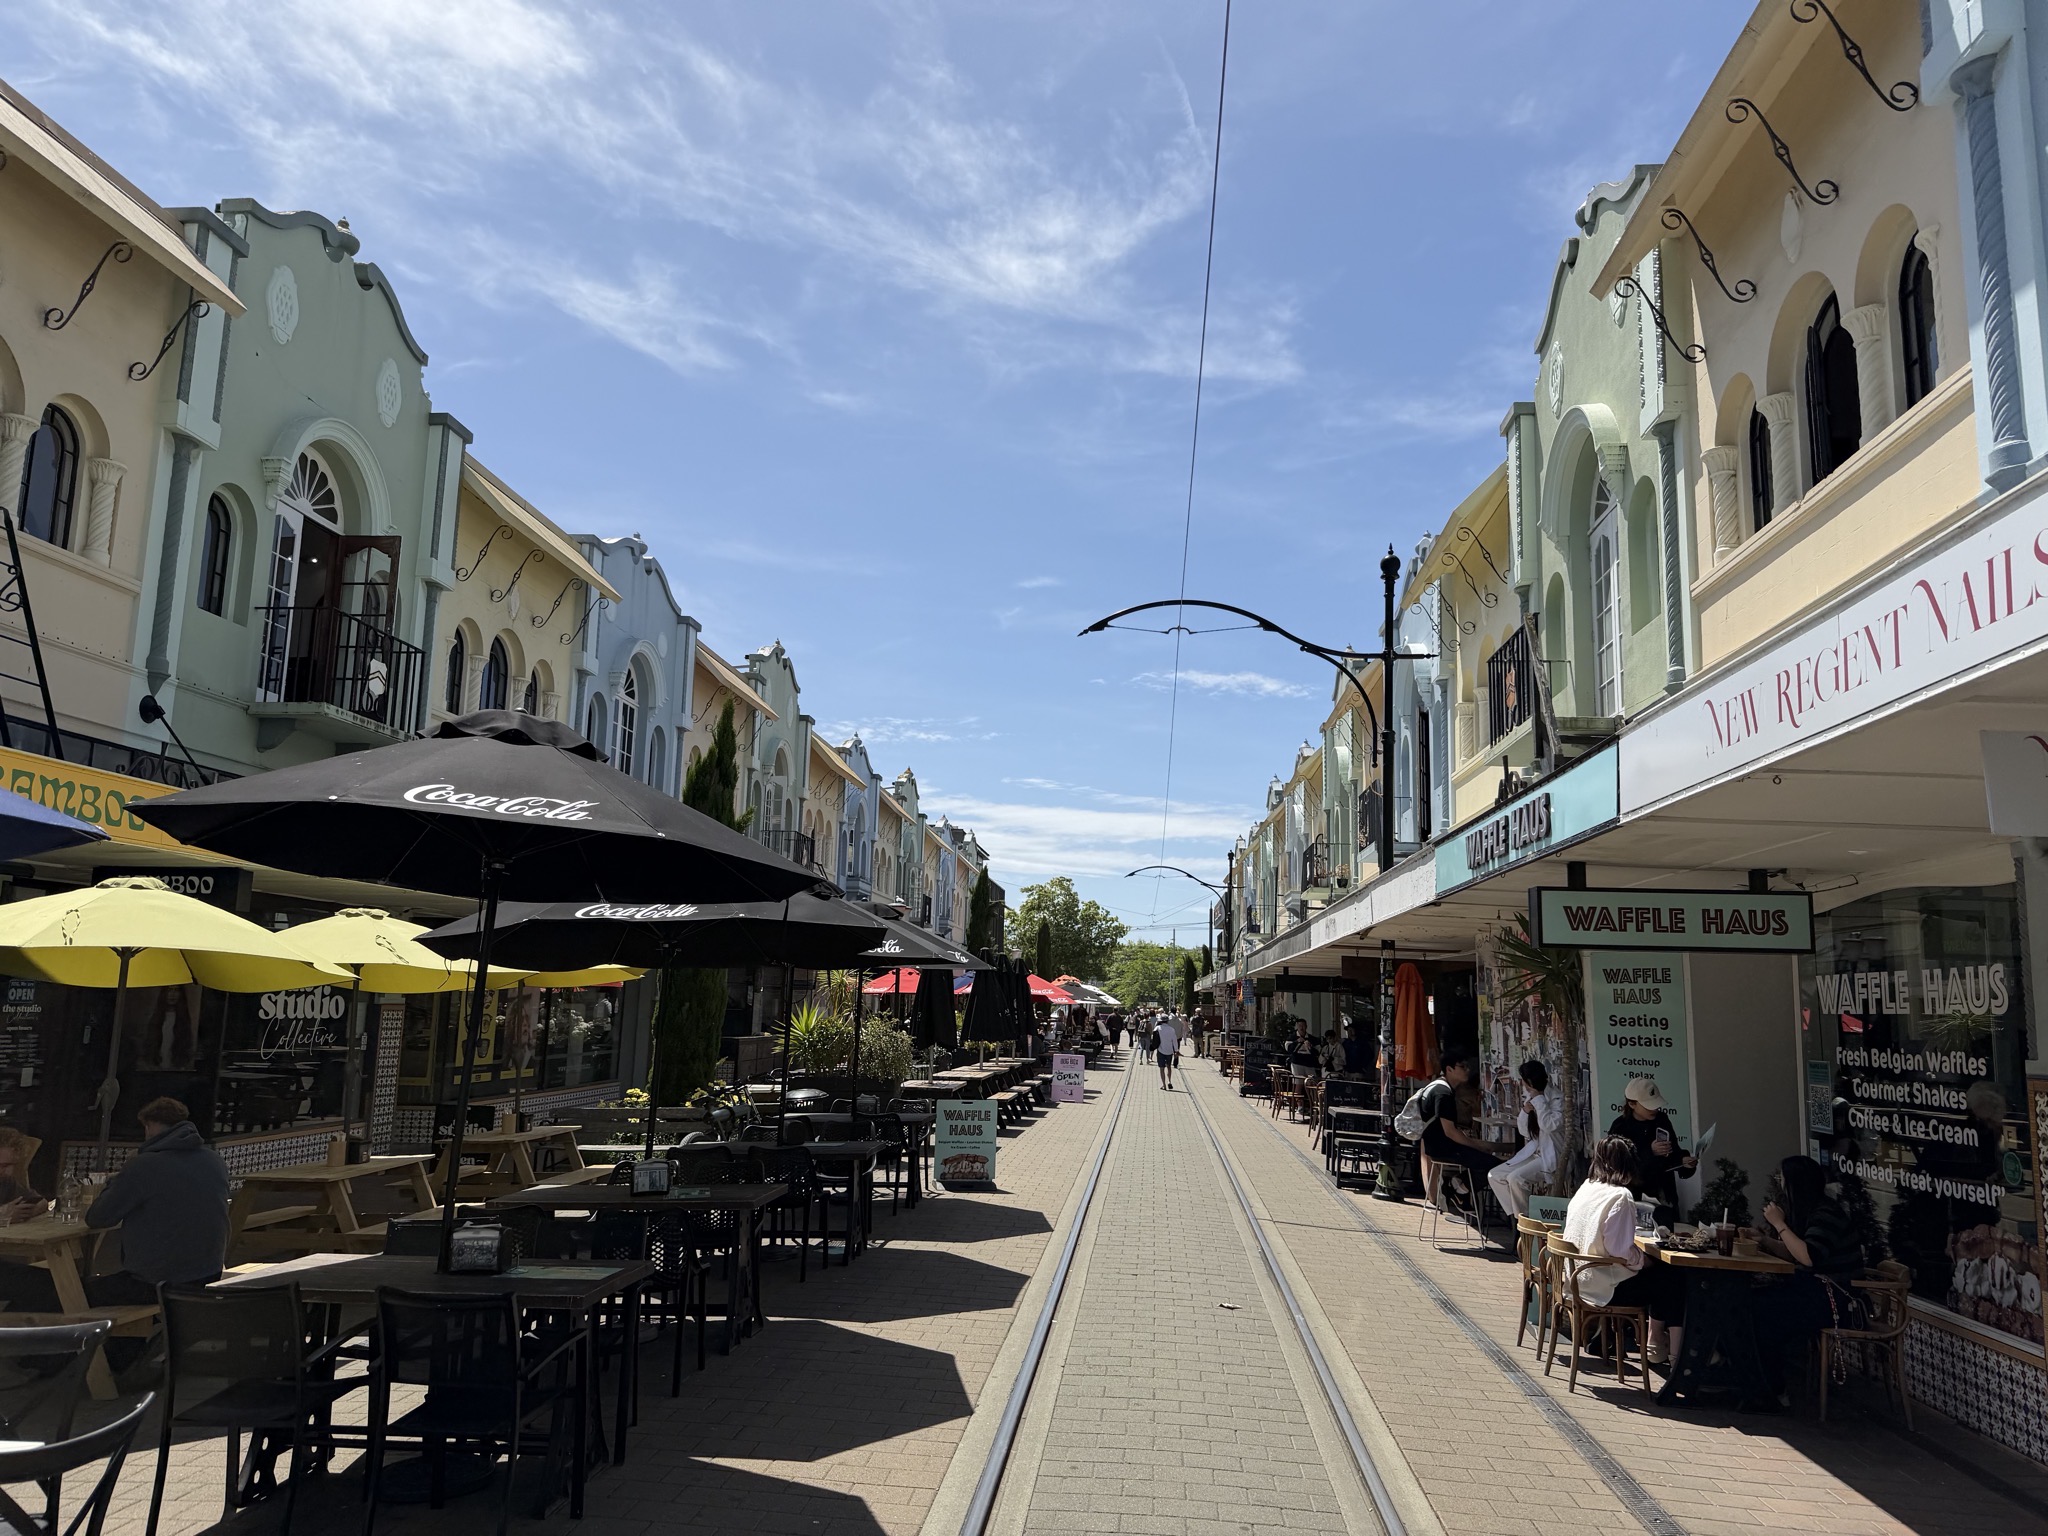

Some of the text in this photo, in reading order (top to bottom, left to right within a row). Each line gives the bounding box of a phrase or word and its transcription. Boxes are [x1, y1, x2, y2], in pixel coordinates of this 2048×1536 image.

[1702, 683, 1763, 757] NEW
[1775, 604, 1909, 729] REGENT
[403, 783, 600, 821] Coca-Cola
[1465, 792, 1551, 870] WAFFLE HAUS
[574, 902, 700, 920] Coca-Cola
[1563, 906, 1789, 936] WAFFLE HAUS
[1603, 967, 1672, 984] WAFFLE
[1815, 963, 2009, 1016] WAFFLE HAUS
[3, 1004, 42, 1013] the studio
[9, 988, 34, 1000] OPEN
[258, 985, 345, 1020] studio
[1613, 988, 1662, 1005] HAUS
[1609, 1014, 1669, 1030] Seating
[260, 1017, 338, 1060] Collective
[1607, 1033, 1673, 1049] Upstairs
[1622, 1057, 1661, 1068] Catchup
[1836, 1046, 1987, 1077] Fresh Belgian Waffles
[1852, 1078, 1968, 1110] Gourmet Shakes
[943, 1110, 991, 1121] WAFFLE
[949, 1124, 984, 1136] HAUS
[1848, 1108, 1979, 1147] Coffee & Ice Cream
[1855, 1158, 1898, 1188] ahead,
[1900, 1168, 1932, 1192] treat
